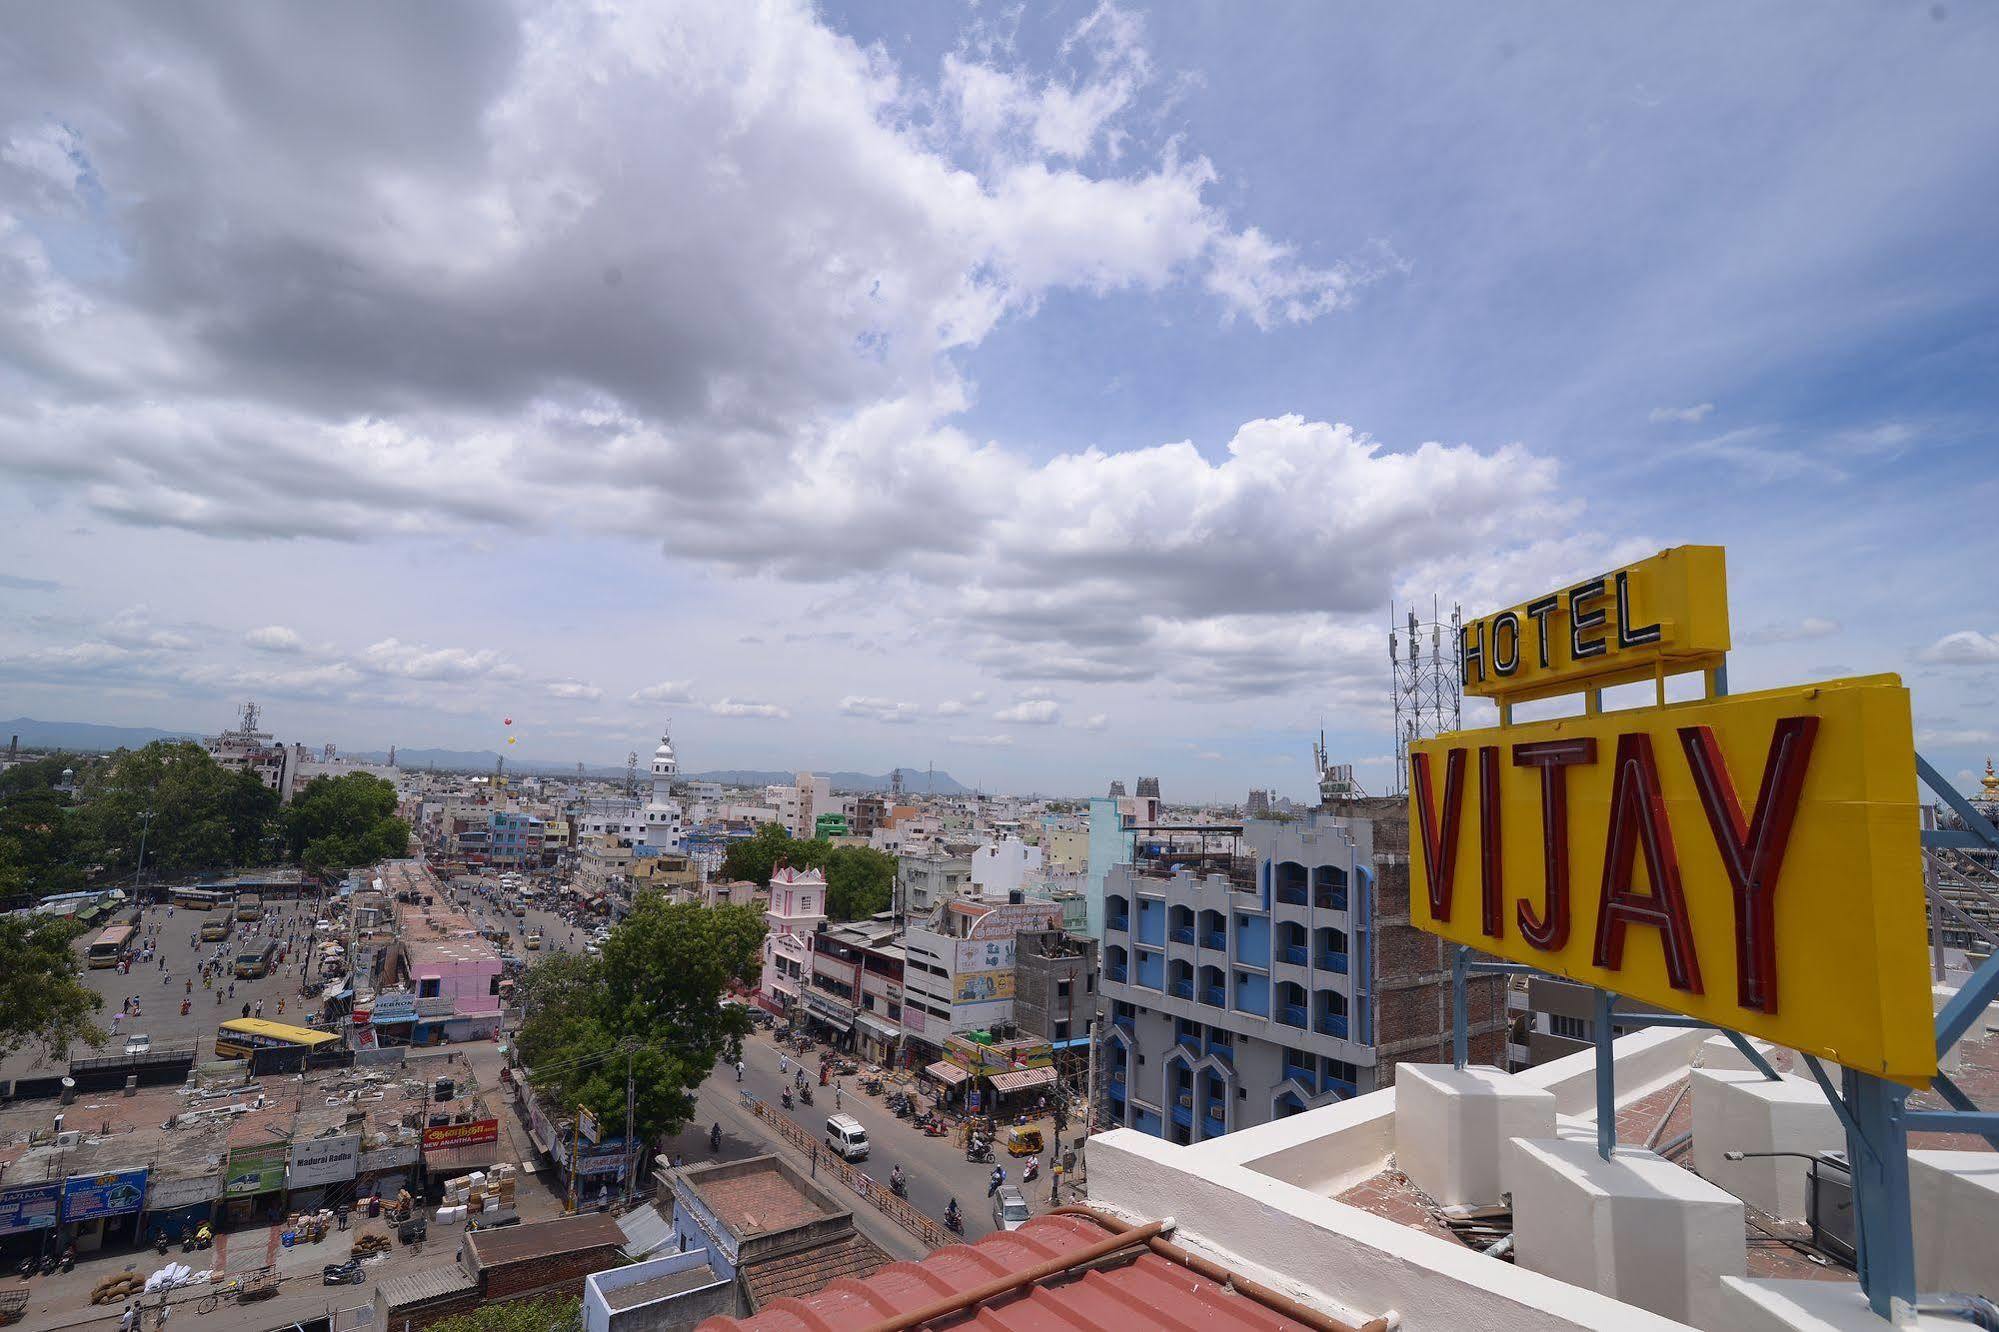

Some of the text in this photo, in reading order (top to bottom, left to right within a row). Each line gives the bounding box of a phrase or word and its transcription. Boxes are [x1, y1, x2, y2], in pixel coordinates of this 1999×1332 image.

[1460, 570, 1661, 686] HOTEL
[1411, 716, 1820, 1015] VIJAY
[296, 1156, 328, 1168] Madurai
[328, 1151, 352, 1163] Radha
[423, 1141, 440, 1149] NEW
[440, 1136, 472, 1147] ANANTHA
